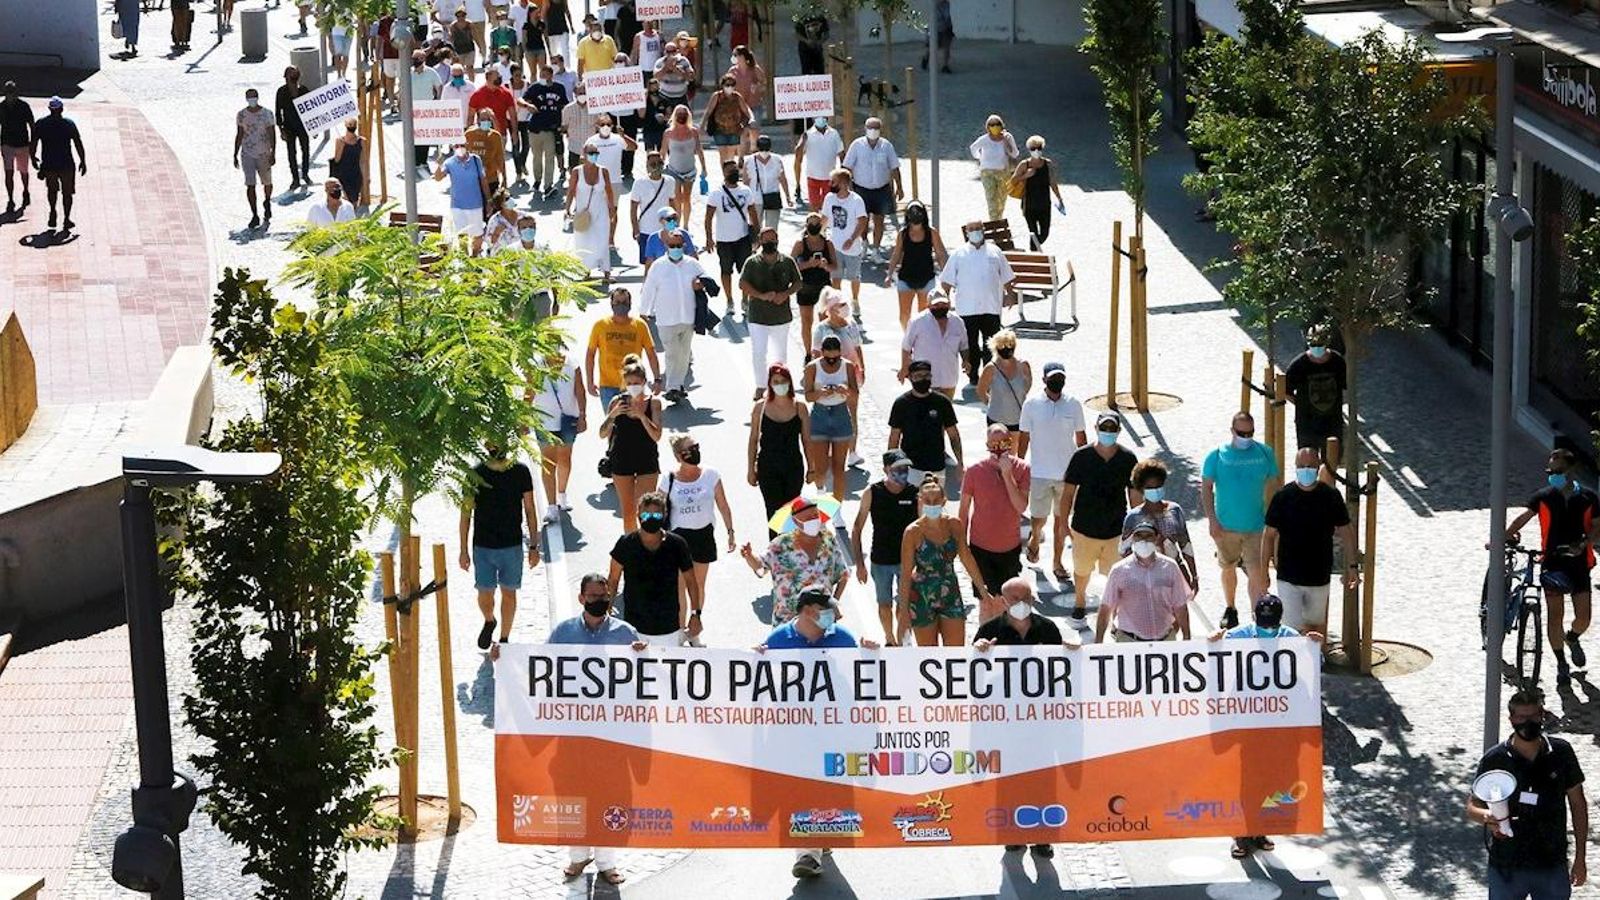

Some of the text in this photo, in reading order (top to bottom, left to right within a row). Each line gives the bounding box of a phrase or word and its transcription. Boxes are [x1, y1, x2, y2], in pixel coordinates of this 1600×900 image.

[638, 5, 680, 16] REDUCIDO
[588, 71, 641, 88] AYUDAS AL ALQUILER
[777, 80, 830, 93] AYUDAS AL ALQUILER
[297, 83, 349, 115] BENIDORM
[589, 91, 644, 108] DEL LOCAL COMERCIAL
[778, 100, 832, 113] DEL LOCAL COMERCIAL
[304, 101, 356, 131] DESTINO SEGURO
[528, 648, 1298, 702] RESPETO PARA EL SECTOR TURISTICO
[535, 694, 1289, 727] JUSTICIA PARA LA RESTAURACION, EL OCIO, EL COMERCIO, LA HOSTELERIA Y LOS SERVICIOS
[874, 730, 950, 750] JUNTOS POR
[823, 749, 1002, 778] BENIDORM
[542, 804, 582, 815] AVIBE
[629, 807, 674, 819] TERRA
[1086, 815, 1150, 834] ociobal
